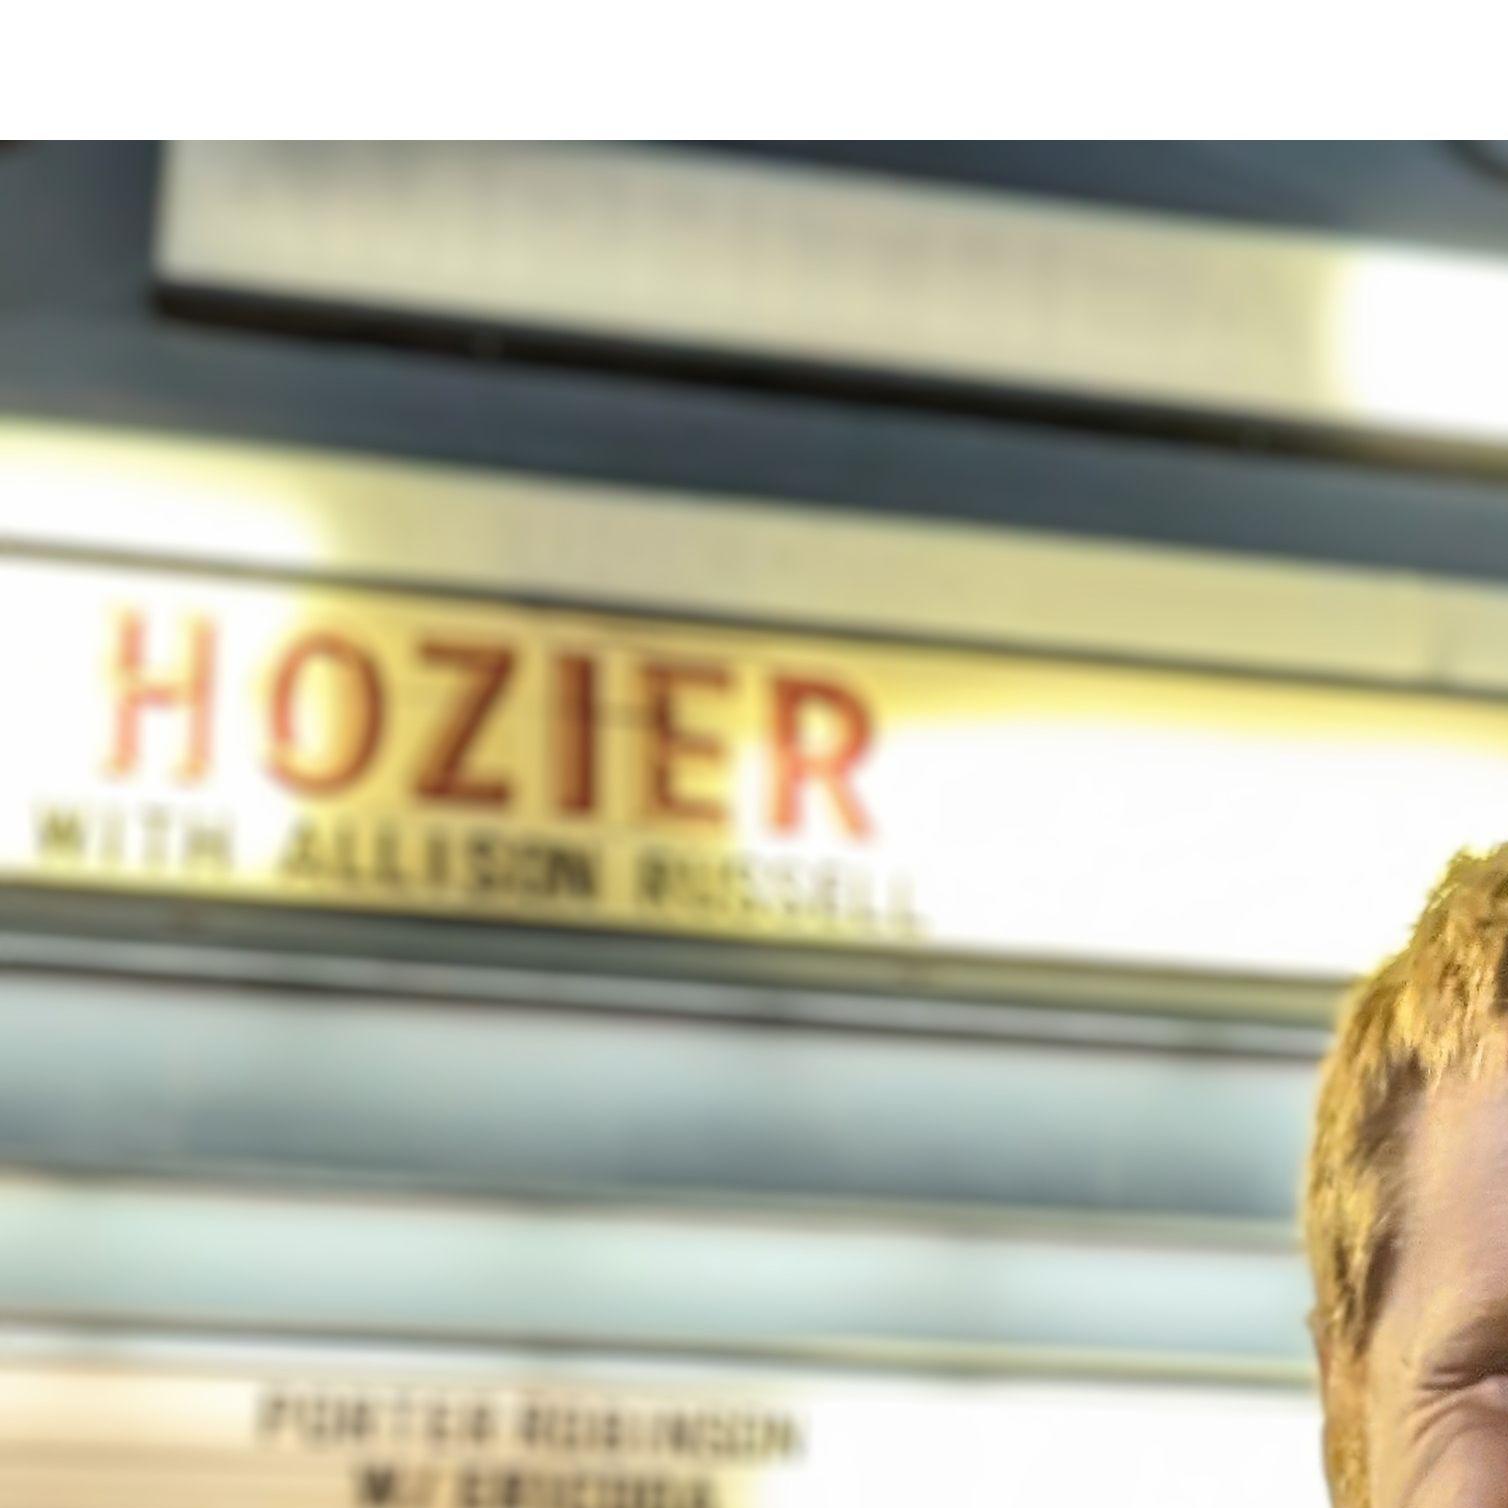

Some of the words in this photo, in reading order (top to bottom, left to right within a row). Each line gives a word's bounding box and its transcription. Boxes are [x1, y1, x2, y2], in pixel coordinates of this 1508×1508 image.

[104, 606, 880, 842] HOZIER
[33, 798, 234, 872] WITH
[282, 818, 602, 903] ALLISON
